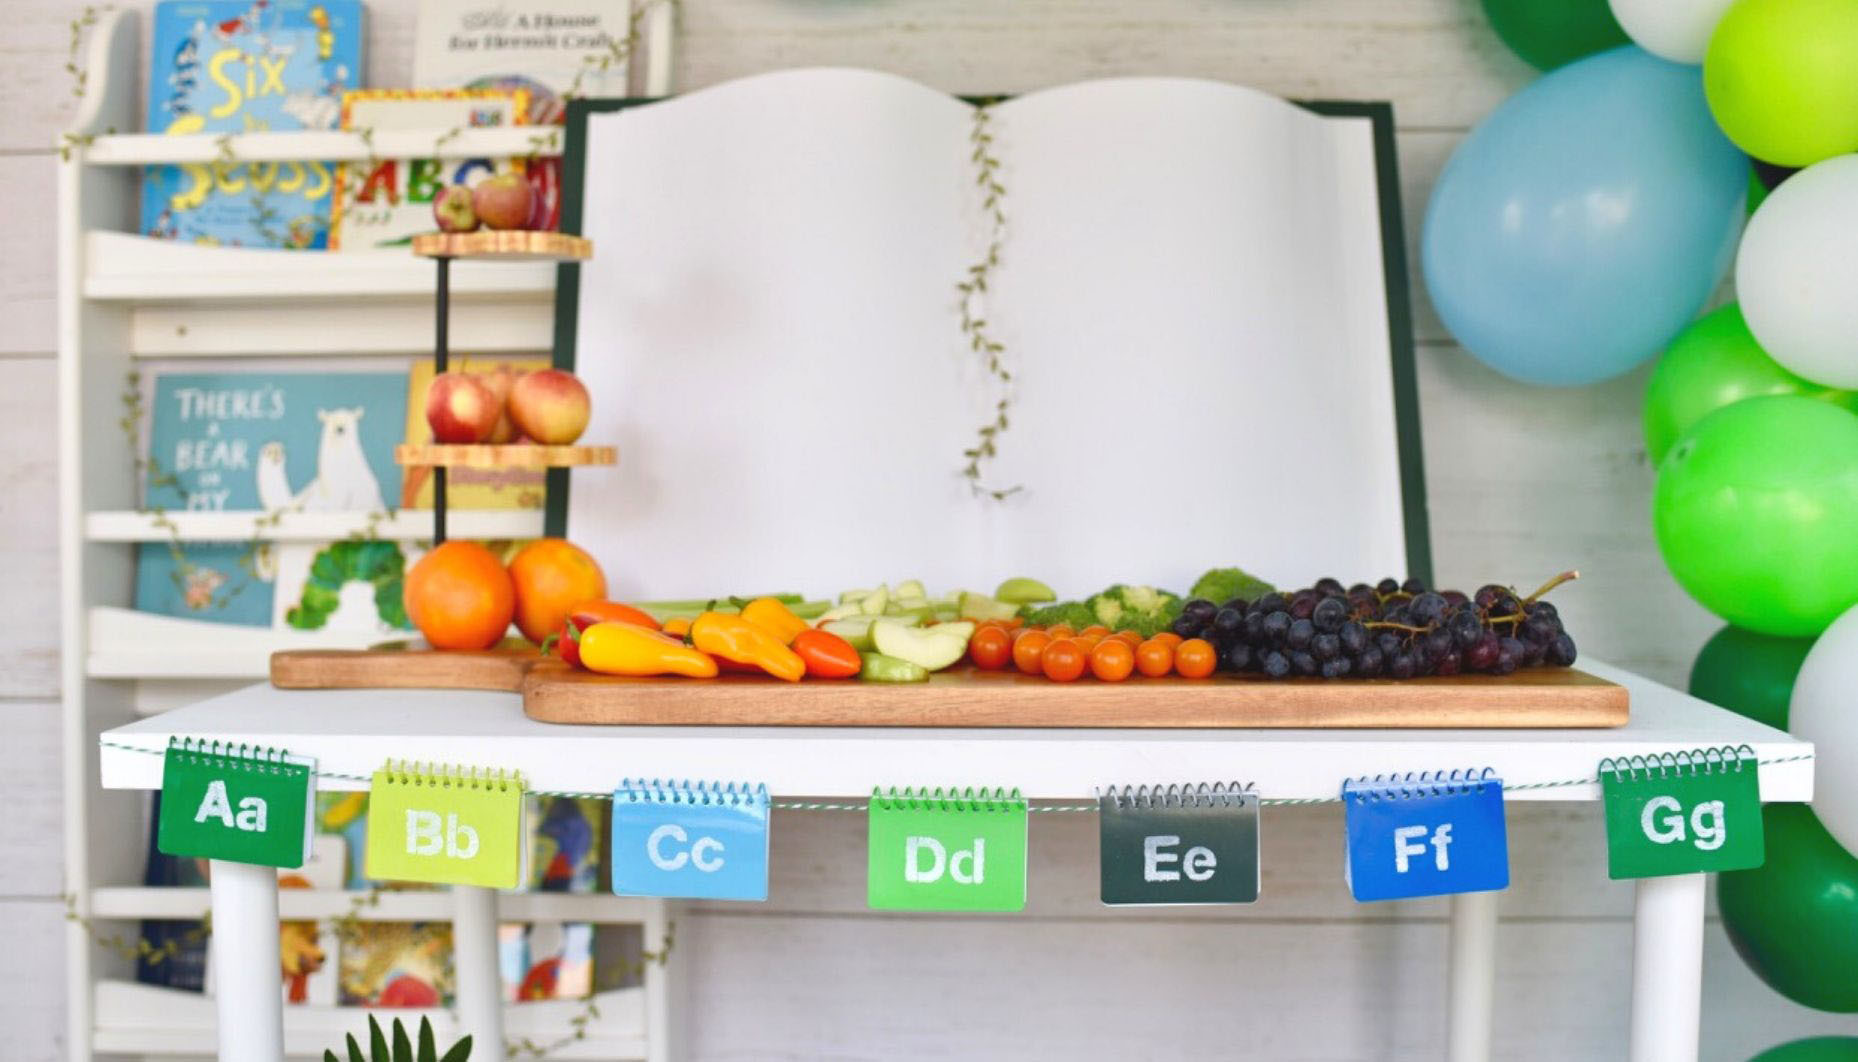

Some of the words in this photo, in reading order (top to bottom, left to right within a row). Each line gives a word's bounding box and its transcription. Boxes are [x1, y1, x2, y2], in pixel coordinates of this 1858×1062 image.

[208, 48, 286, 119] Six
[173, 384, 286, 423] THERE'S
[175, 440, 250, 473] BEAR
[194, 780, 268, 833] Aa
[1640, 795, 1727, 851] Gg
[405, 808, 481, 860] Bb
[646, 823, 725, 873] Cc
[1143, 835, 1218, 882] Ee
[1394, 823, 1453, 873] Ff
[905, 836, 985, 884] Dd
